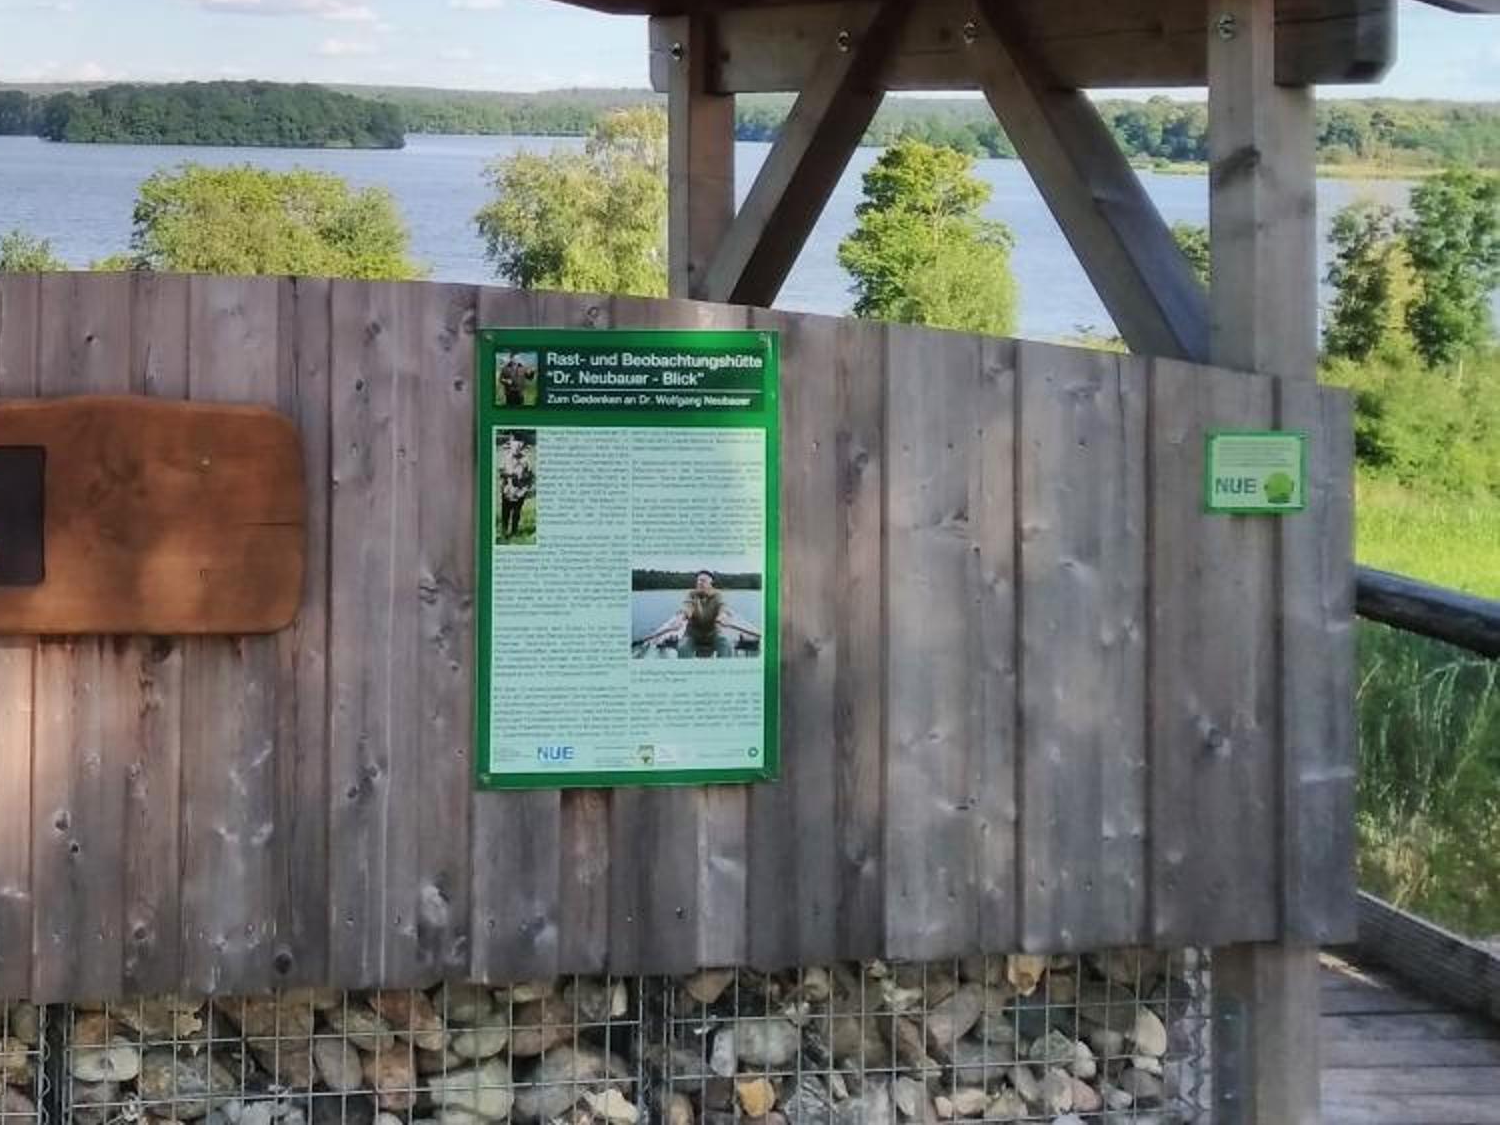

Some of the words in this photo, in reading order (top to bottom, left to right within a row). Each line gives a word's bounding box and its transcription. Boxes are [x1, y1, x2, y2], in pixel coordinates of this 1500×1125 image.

[547, 352, 587, 366] Rast-
[589, 353, 618, 366] und
[621, 352, 763, 370] Beobachtungshütte
[579, 370, 649, 385] Neubauer
[547, 393, 570, 404] Zum
[571, 393, 622, 405] Gedenken
[623, 395, 637, 405] an
[639, 394, 654, 405] Dr.
[655, 395, 702, 408] Wolfgang
[1215, 477, 1258, 495] NUE
[537, 746, 575, 761] NUE
